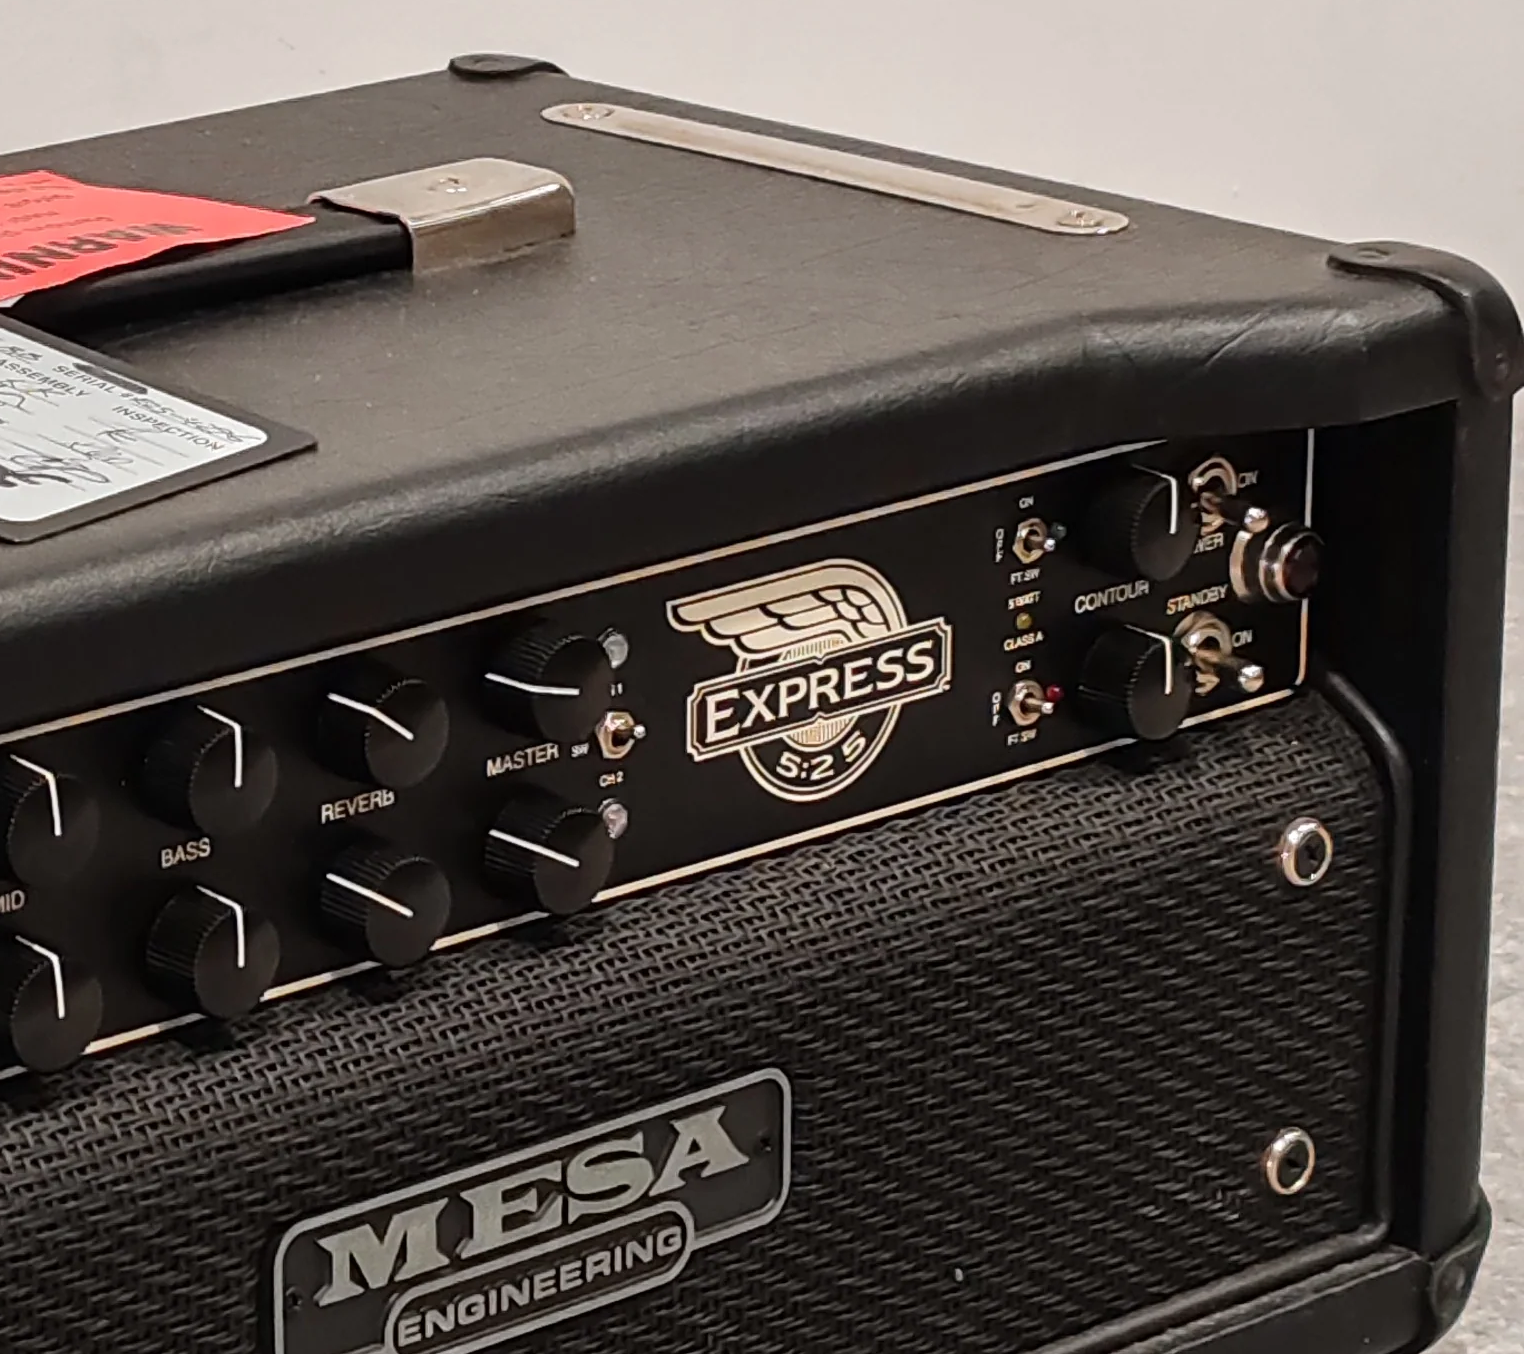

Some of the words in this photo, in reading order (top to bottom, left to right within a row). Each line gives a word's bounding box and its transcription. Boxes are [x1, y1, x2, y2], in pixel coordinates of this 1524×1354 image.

[52, 364, 116, 393] SERIAL
[112, 405, 225, 452] INSPECTION
[1237, 470, 1260, 489] ON
[1073, 579, 1150, 614] CONTOUR
[1165, 583, 1229, 616] STANDBY
[1003, 632, 1035, 651] CLASS
[1232, 629, 1253, 648] ON
[703, 638, 936, 745] EXPRESS
[486, 742, 560, 778] MASTER
[775, 729, 867, 782] 5:25
[320, 788, 396, 825] REVERB
[160, 837, 212, 869] BASS
[312, 1104, 750, 1308] MESA
[396, 1225, 684, 1347] ENGINEERING
